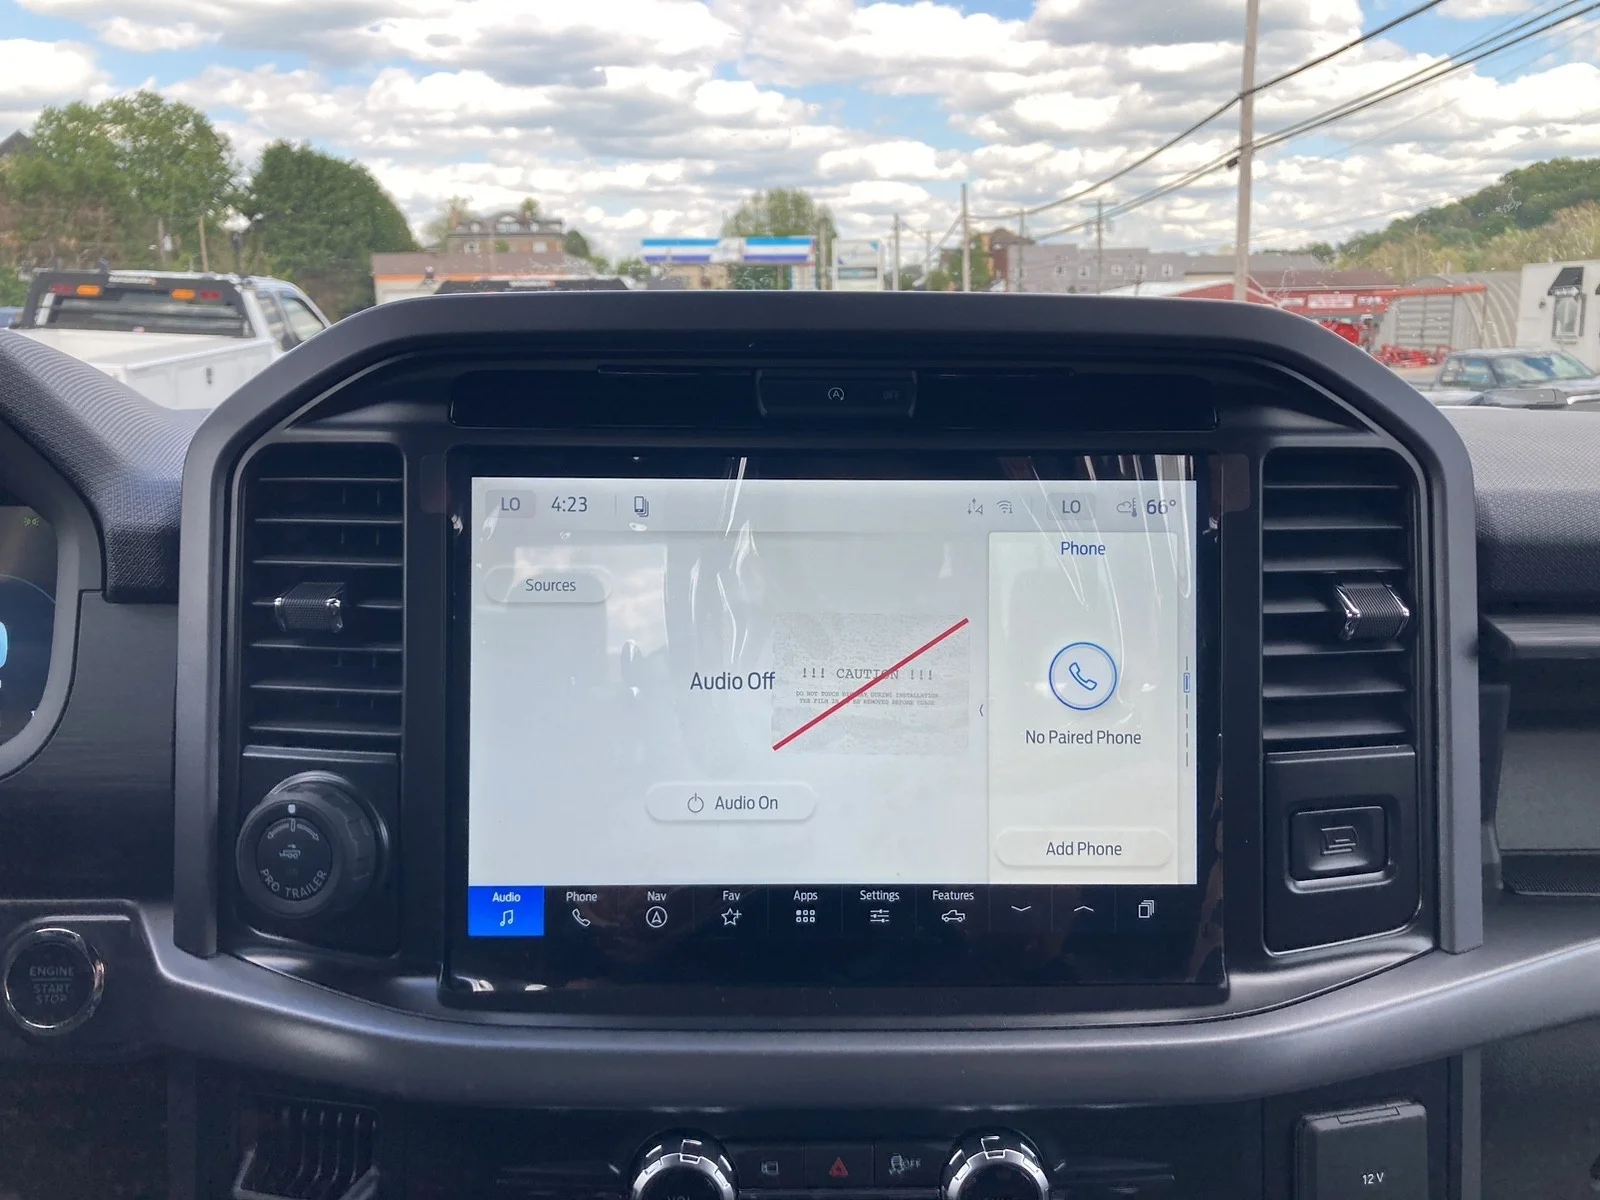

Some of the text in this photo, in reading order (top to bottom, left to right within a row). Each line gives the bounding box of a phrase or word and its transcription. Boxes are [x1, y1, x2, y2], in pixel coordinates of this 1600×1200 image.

[500, 497, 521, 511] LO
[551, 496, 588, 513] 4:23
[1062, 500, 1081, 514] LO
[1146, 499, 1177, 515] 66°
[1061, 541, 1106, 556] Phone
[525, 578, 577, 593] Sources
[690, 671, 776, 691] Audio Off
[1025, 729, 1142, 745] No Paired Phone
[714, 794, 779, 811] Audio On
[1045, 840, 1122, 857] Add Phone
[260, 867, 328, 899] PRO TRAILER
[492, 891, 521, 903] Audio
[566, 891, 598, 902] Phone
[647, 891, 667, 902] Nav
[722, 890, 741, 901] Fav
[793, 890, 819, 904] Apps
[859, 890, 900, 903] Settings
[932, 890, 975, 901] Features
[29, 965, 75, 977] ENGINE
[33, 983, 71, 994] START
[35, 994, 68, 1005] STOP
[903, 1158, 921, 1168] OFF
